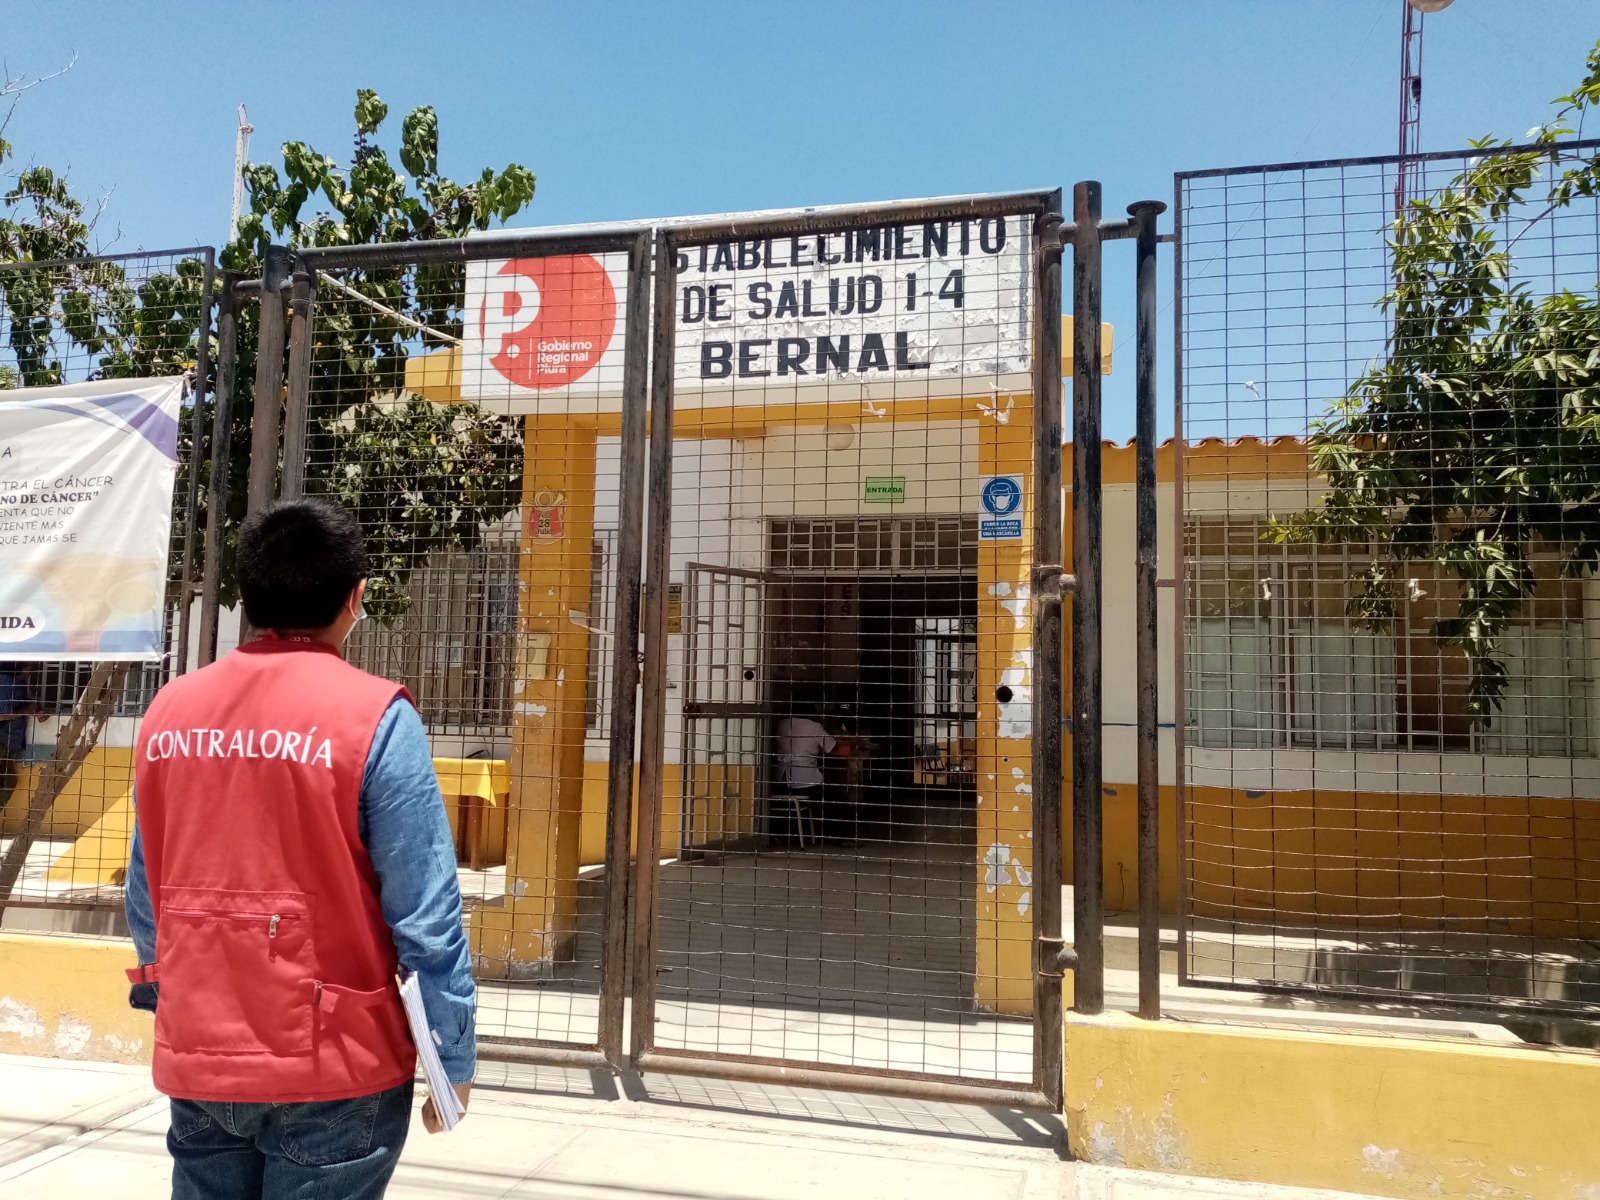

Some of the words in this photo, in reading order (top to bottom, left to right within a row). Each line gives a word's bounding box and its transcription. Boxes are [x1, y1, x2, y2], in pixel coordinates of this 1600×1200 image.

[681, 284, 732, 323] DE
[748, 275, 882, 319] SALUD
[538, 340, 592, 351] Gobierno
[537, 351, 588, 364] Regional
[701, 332, 930, 379] BERNAL
[537, 363, 566, 374] Piura
[33, 480, 49, 490] EL
[55, 475, 113, 488] CÁNCER
[20, 494, 38, 503] DE
[31, 507, 54, 517] QUE
[58, 506, 74, 515] NO
[41, 521, 64, 529] MAS
[538, 518, 550, 528] 28
[22, 534, 59, 544] JAMAS
[62, 533, 77, 542] SE
[146, 726, 333, 769] CONTRALORÍA
